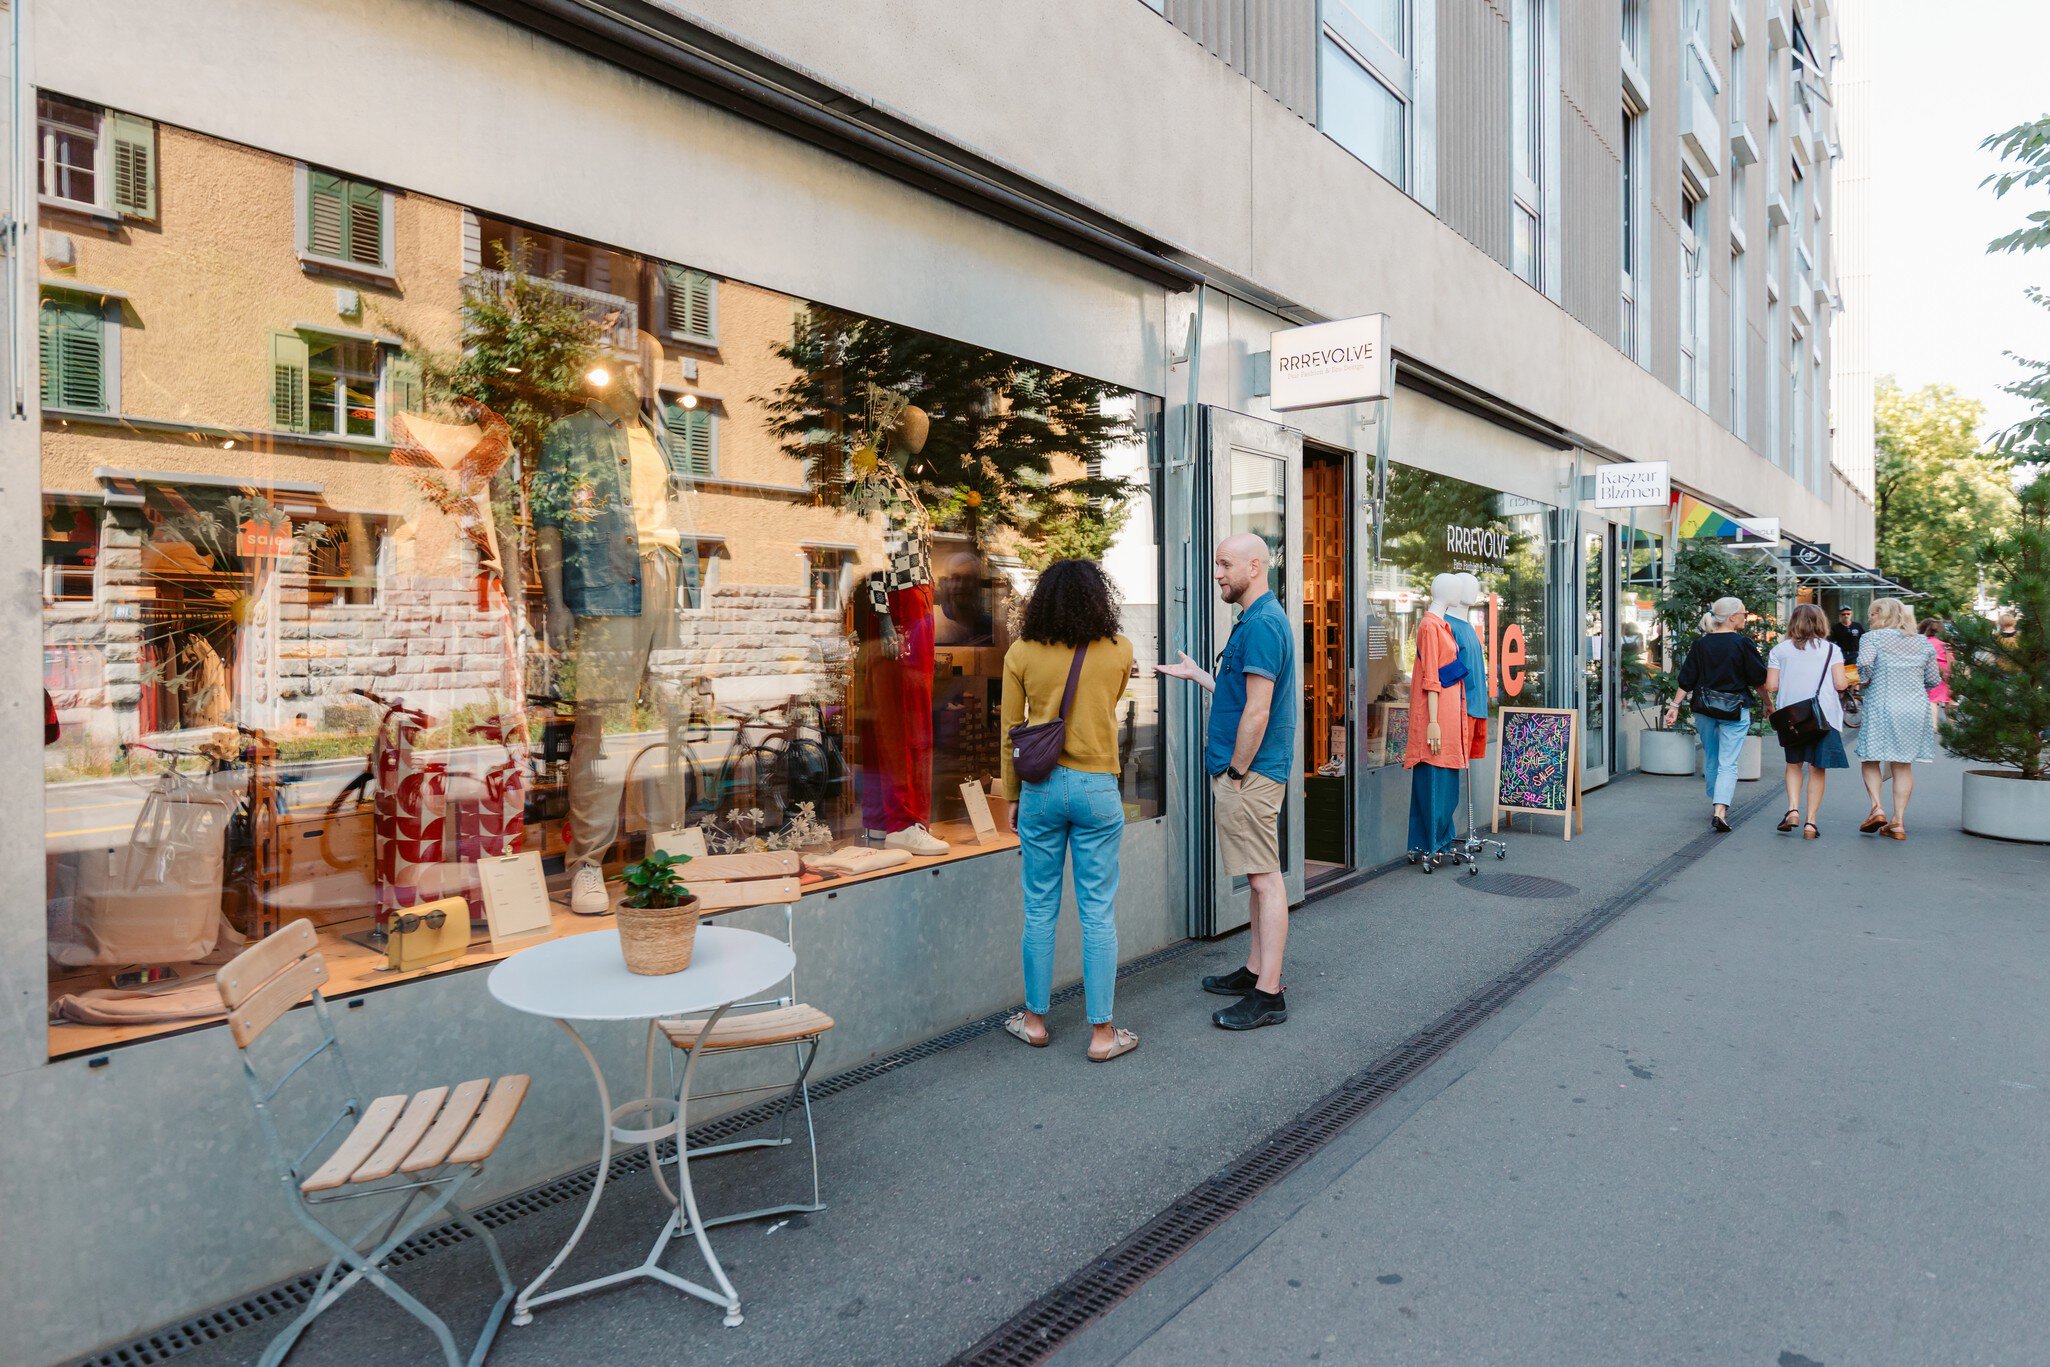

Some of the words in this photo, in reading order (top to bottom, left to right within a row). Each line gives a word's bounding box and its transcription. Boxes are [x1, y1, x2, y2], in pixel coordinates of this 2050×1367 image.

[1280, 342, 1373, 372] RRREVOLVE
[1601, 471, 1657, 487] Kaspar
[1601, 485, 1661, 499] Blumen
[1447, 524, 1509, 560] RRREVOLVE
[1476, 593, 1525, 698] le
